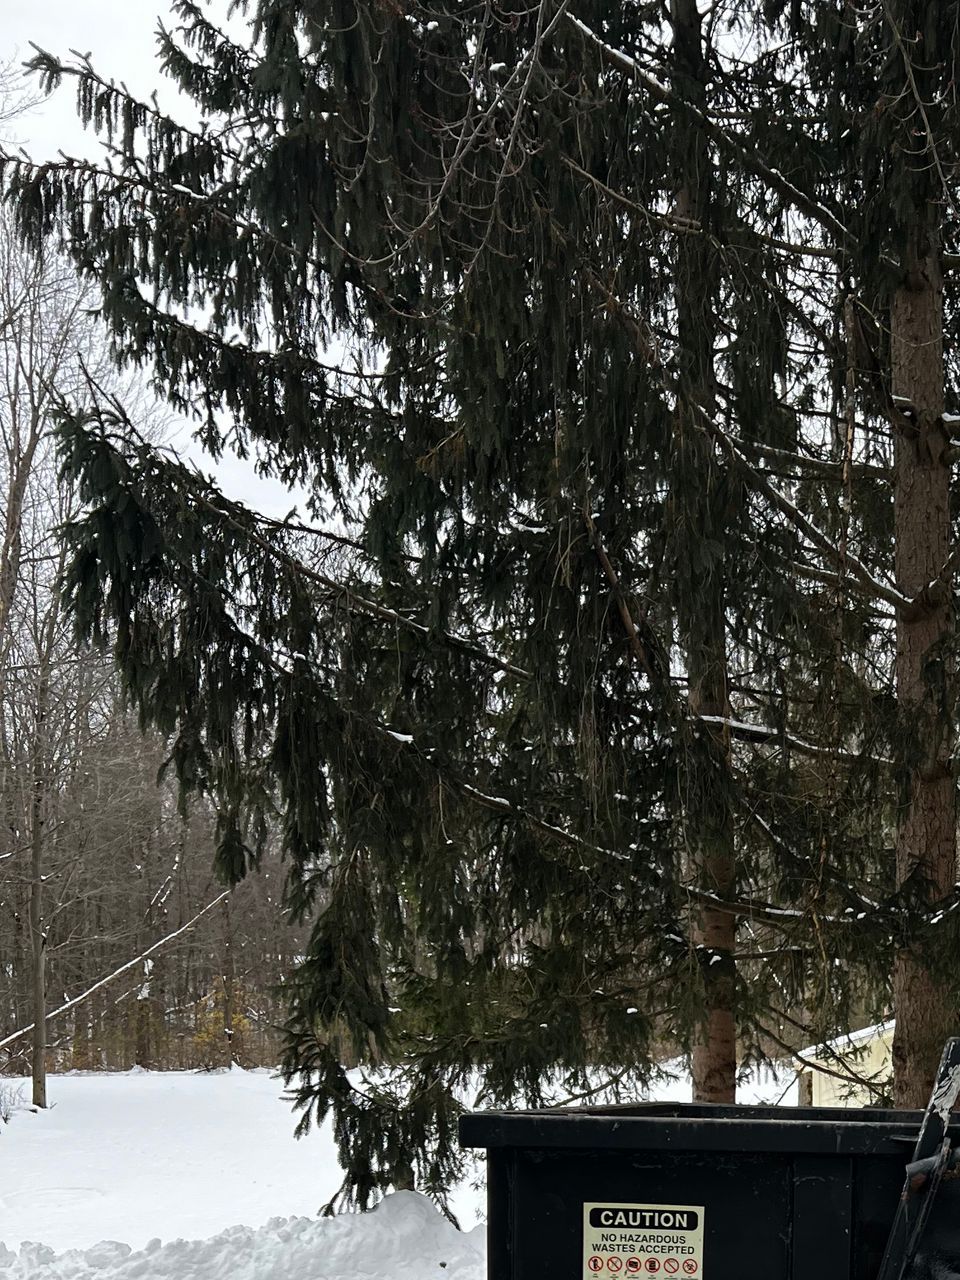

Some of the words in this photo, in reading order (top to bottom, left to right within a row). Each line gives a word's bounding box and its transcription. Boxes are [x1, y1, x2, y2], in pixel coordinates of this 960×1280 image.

[600, 1211, 688, 1228] CAUTION
[601, 1234, 616, 1242] NO
[620, 1234, 686, 1244] HAZARDOUS
[592, 1244, 636, 1252] WASTES
[638, 1245, 694, 1254] ACCEPTED
